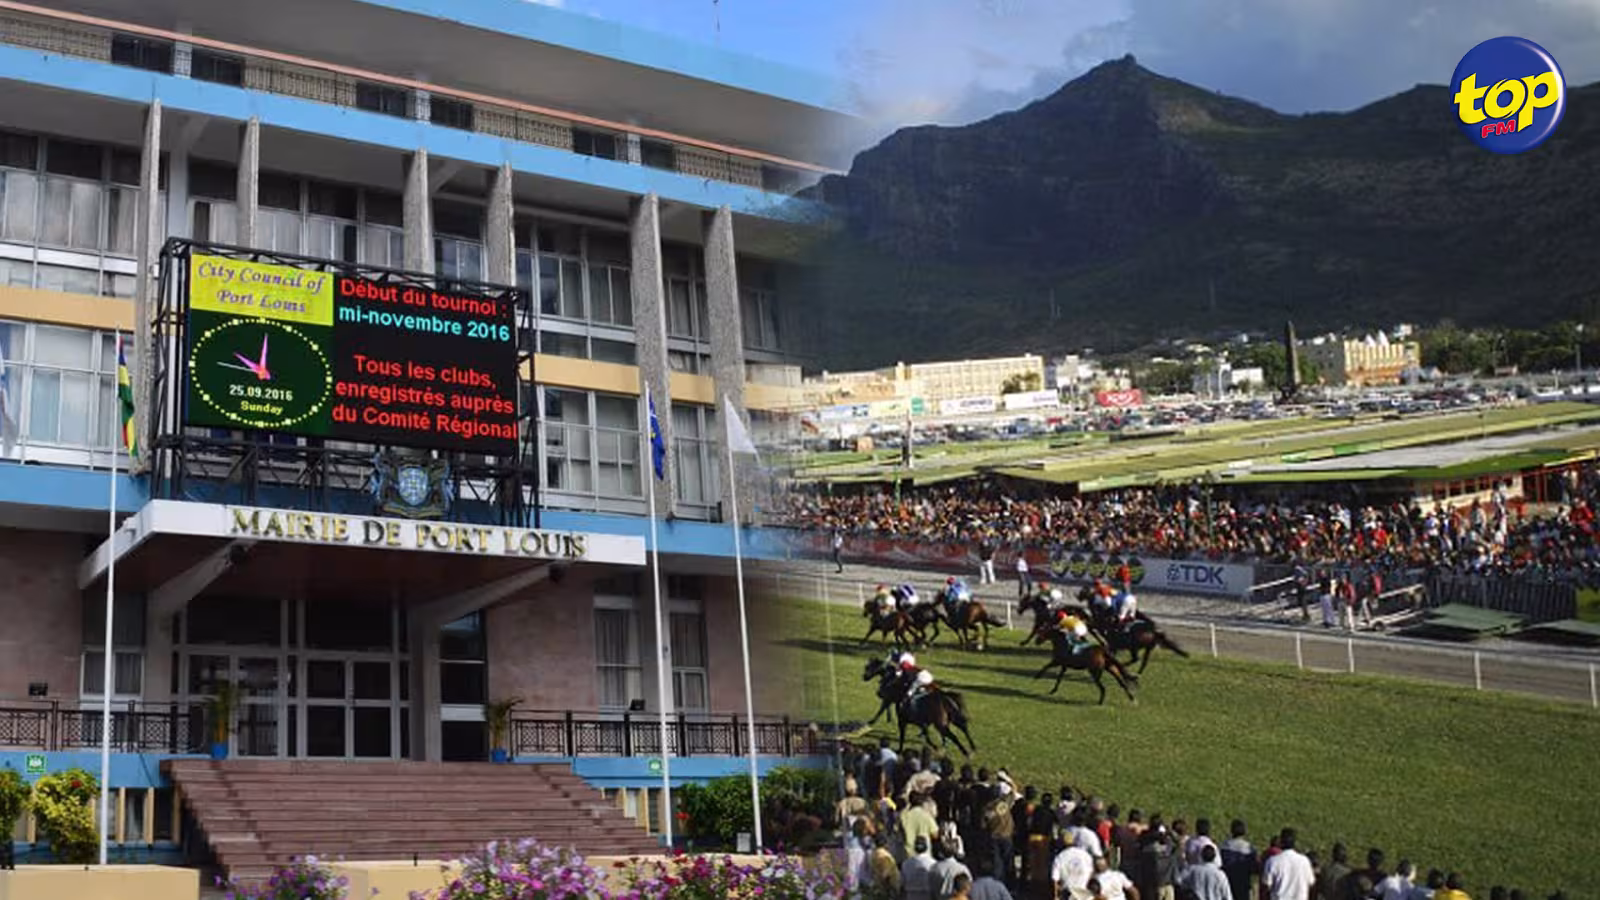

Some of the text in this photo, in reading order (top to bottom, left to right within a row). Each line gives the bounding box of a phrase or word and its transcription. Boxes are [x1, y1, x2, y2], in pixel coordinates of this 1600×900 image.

[198, 261, 326, 296] City Council of
[217, 289, 306, 313] Port Louis
[340, 278, 398, 303] Début
[403, 292, 426, 306] du
[431, 294, 497, 316] tournoi
[339, 306, 510, 342] mi-novembre 2016
[354, 354, 497, 391] Tous les clubs,
[229, 384, 293, 401] 25.09.2016
[241, 400, 283, 416] Sunday
[335, 381, 514, 415] enregistrés auprès
[332, 403, 517, 440] du Comité Régional
[231, 507, 586, 558] MAIRIE DE PORT LOUIS
[1180, 564, 1224, 585] TDK
